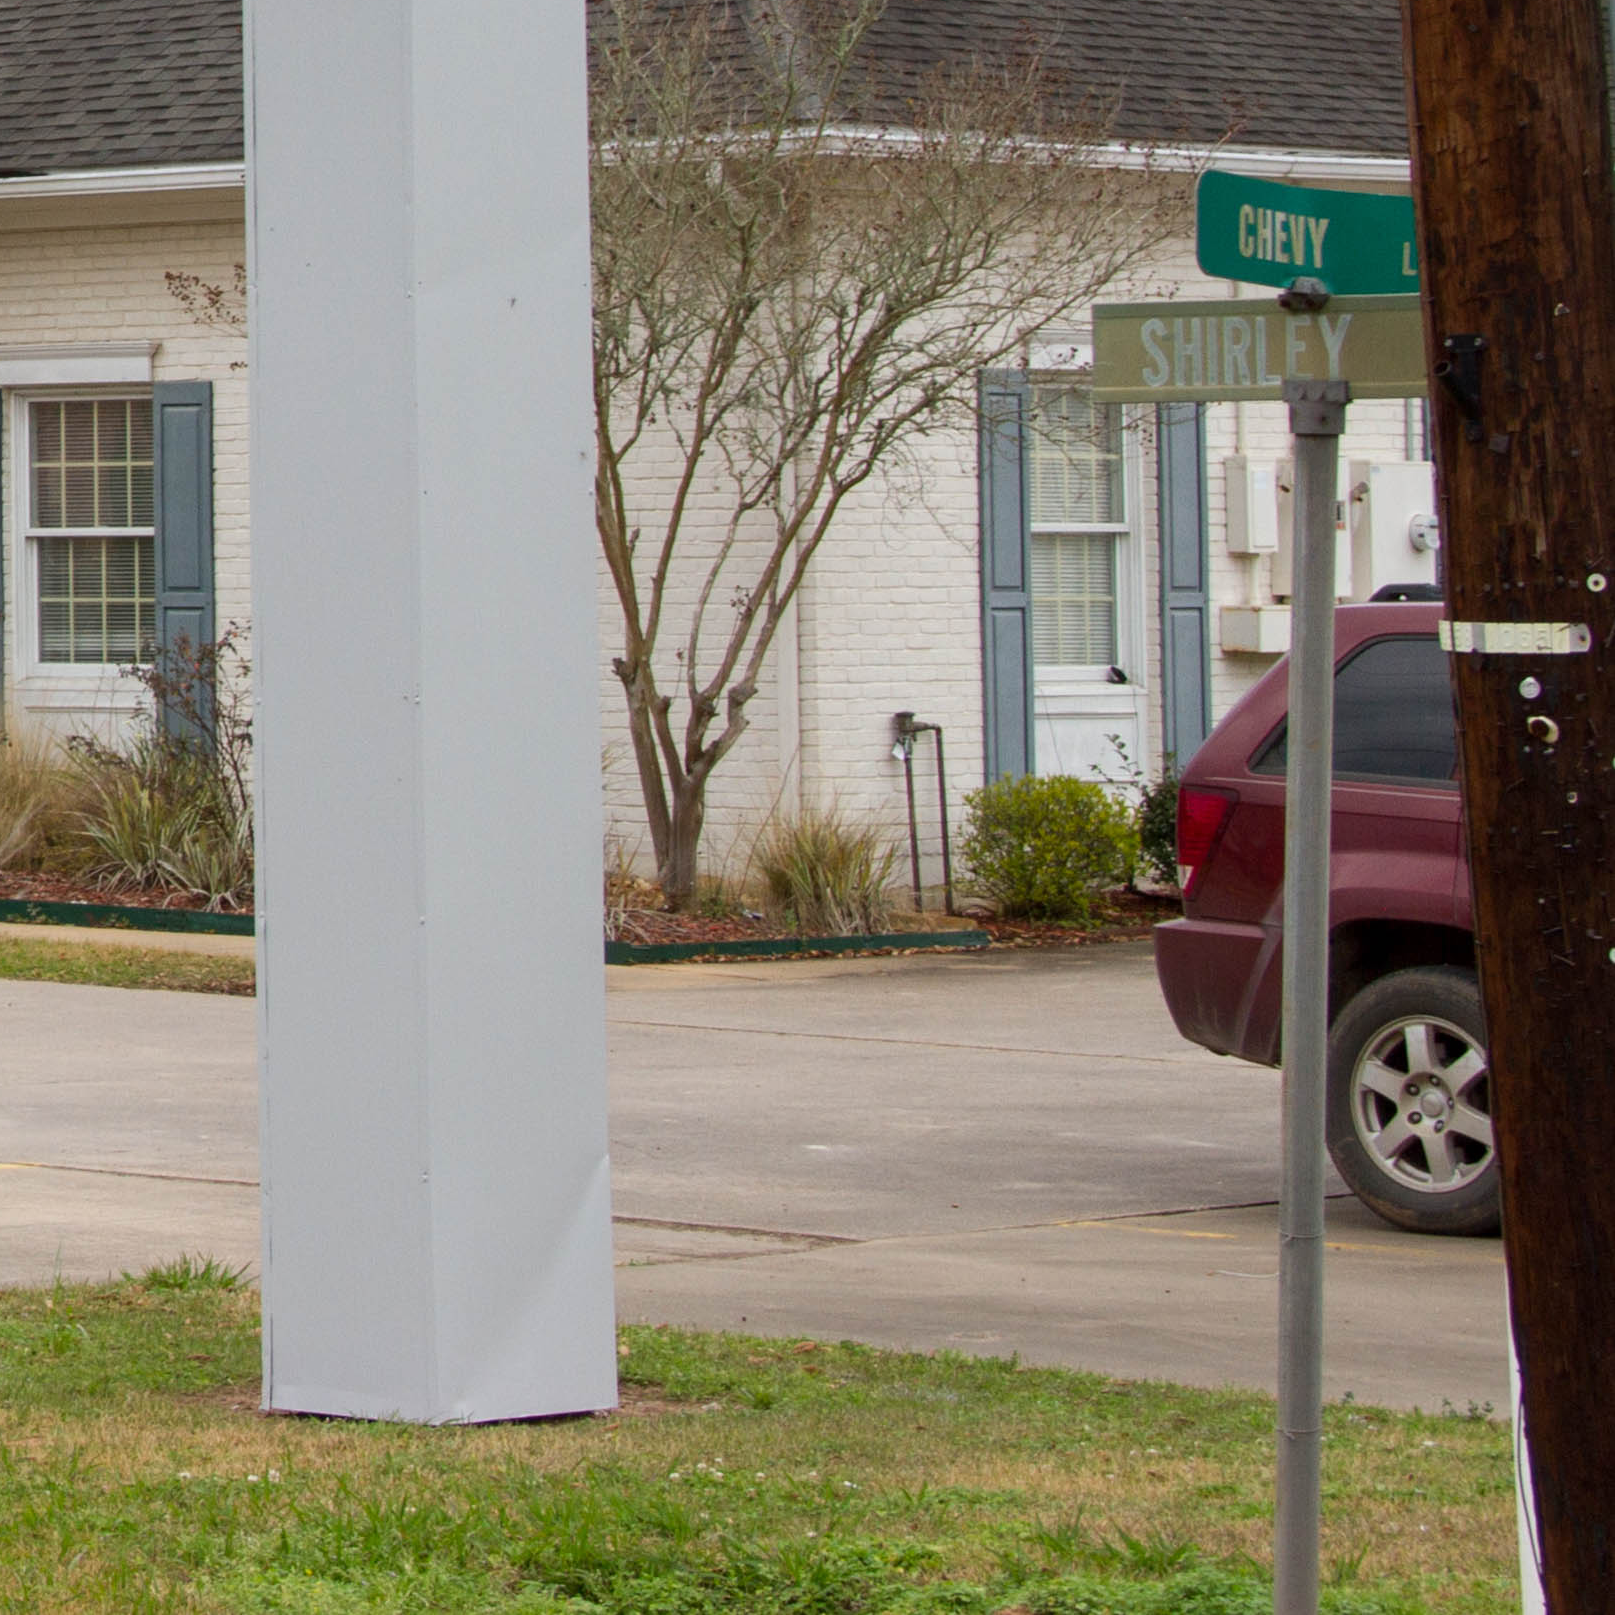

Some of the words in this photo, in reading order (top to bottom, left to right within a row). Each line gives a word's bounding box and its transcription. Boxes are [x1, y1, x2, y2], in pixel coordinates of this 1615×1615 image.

[1238, 203, 1331, 269] CHEVY
[1401, 240, 1419, 276] L
[1140, 313, 1355, 388] SHIRLEY
